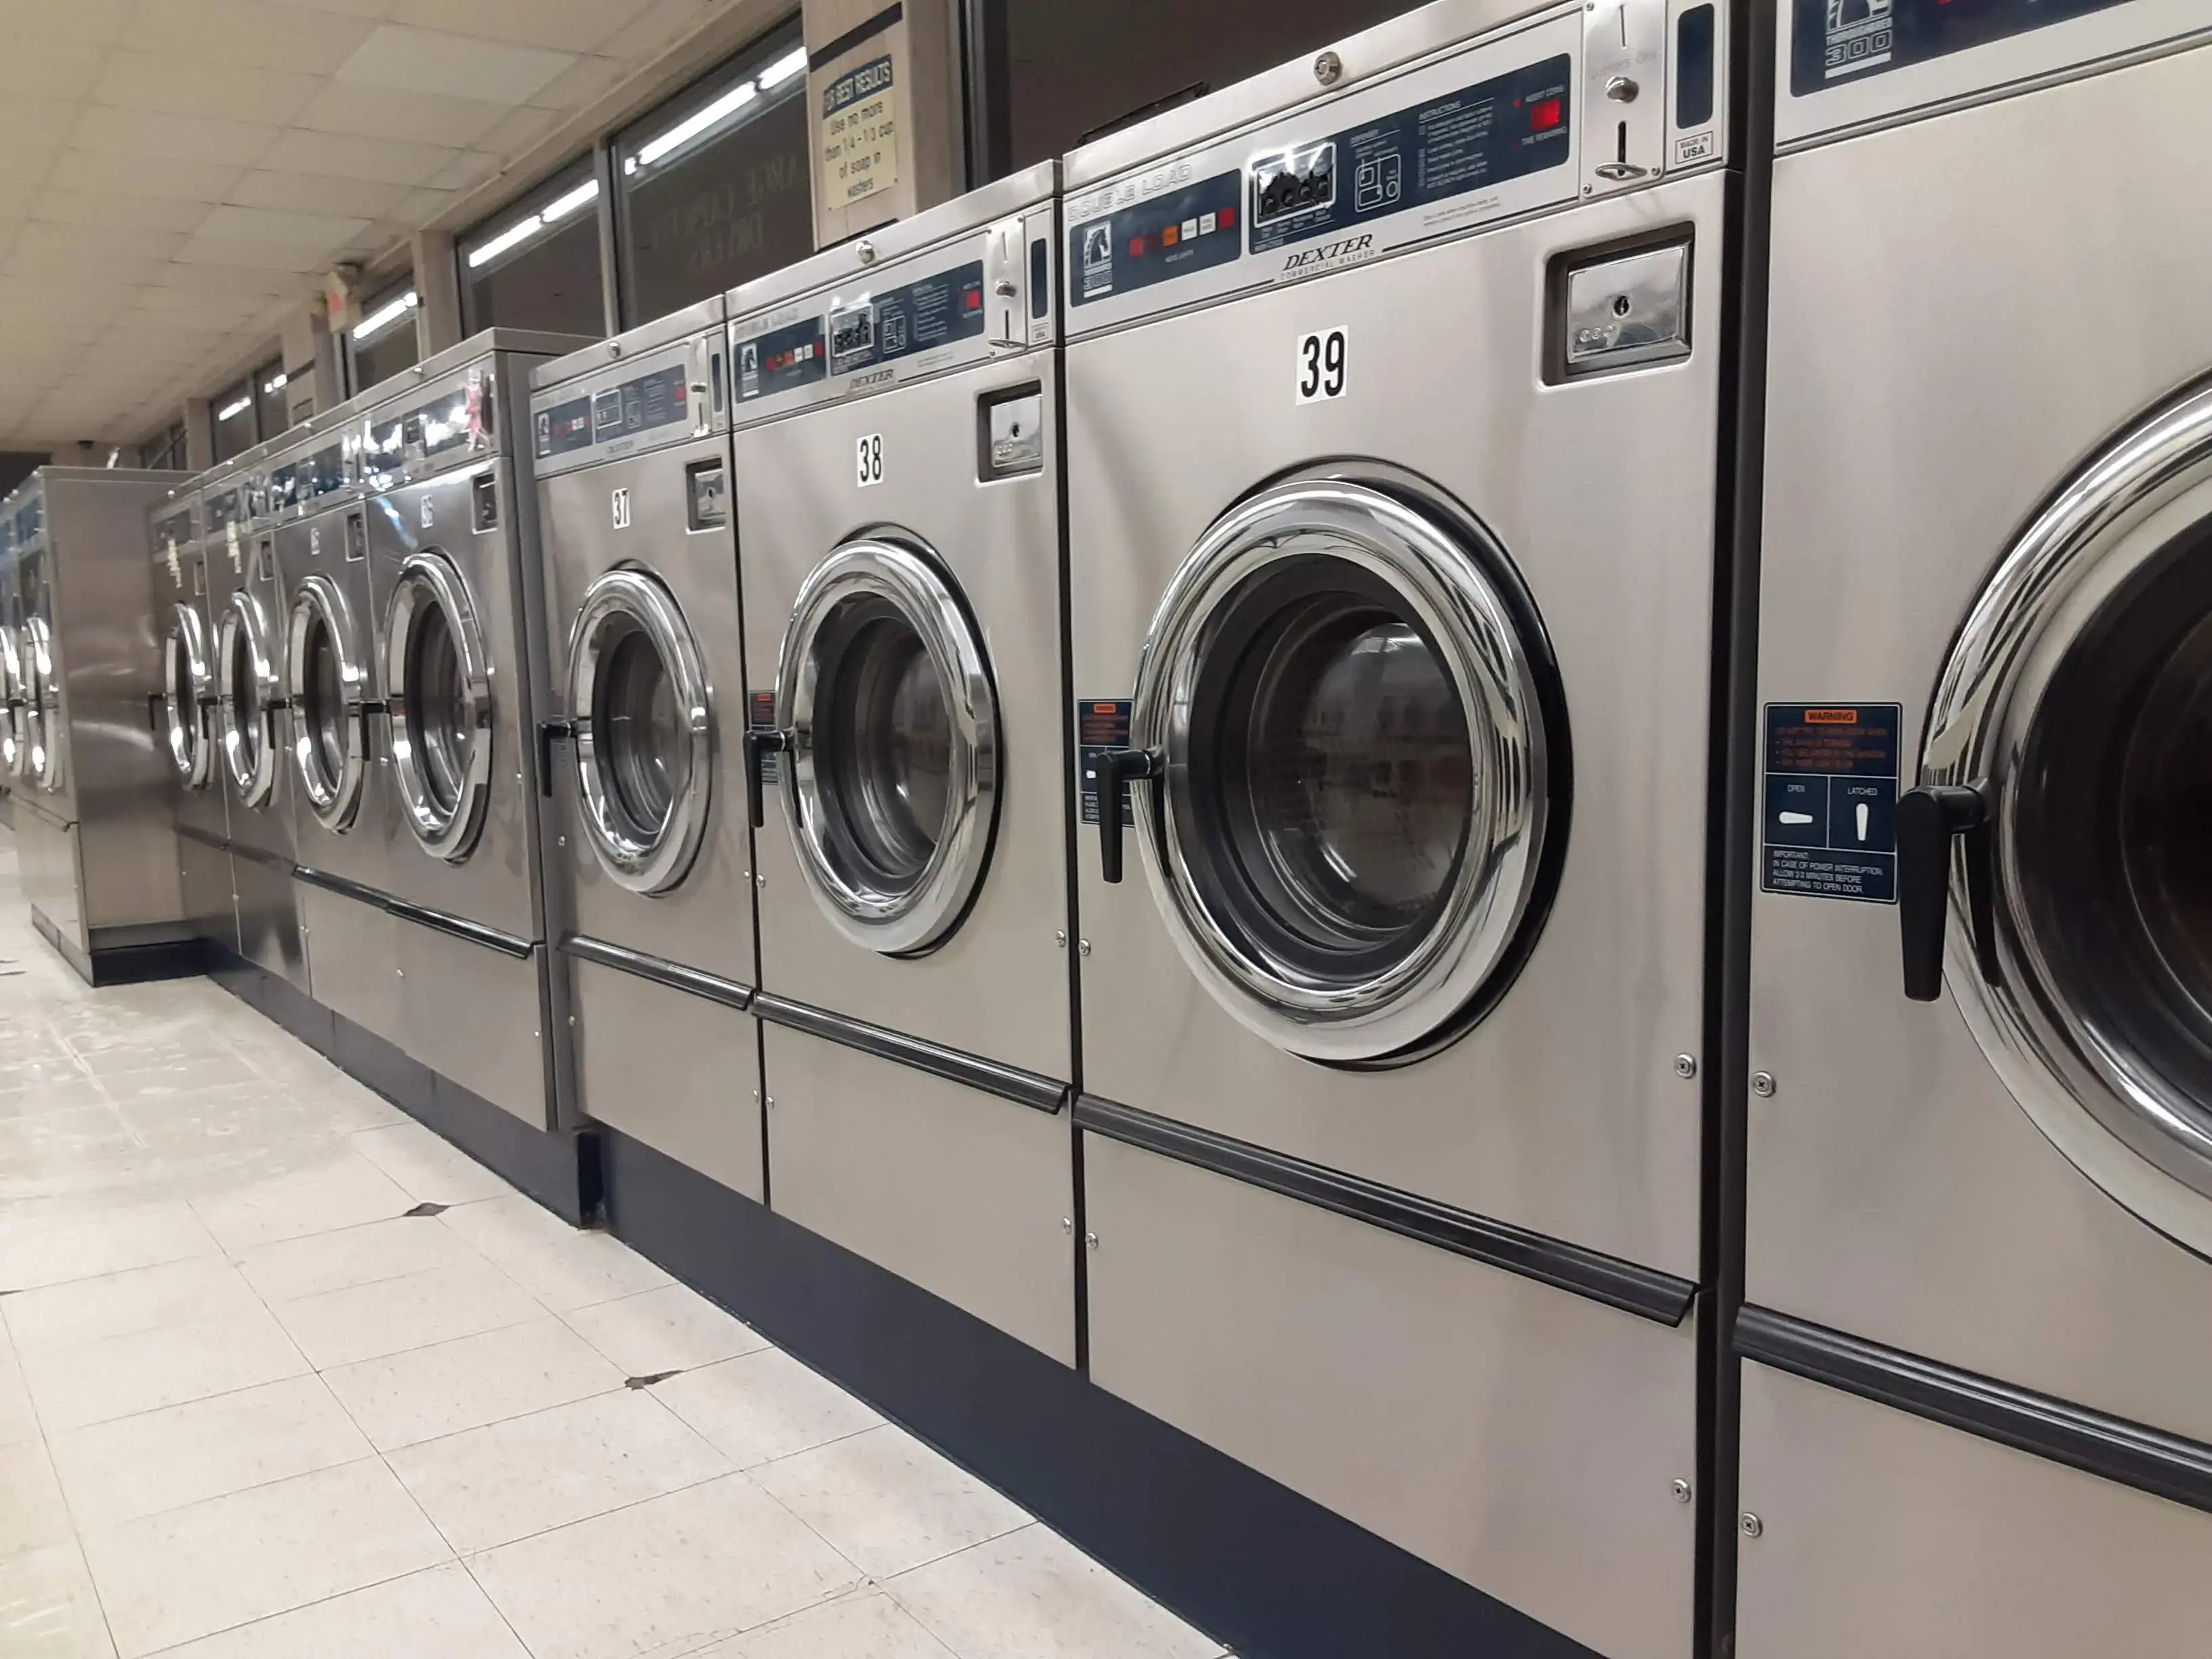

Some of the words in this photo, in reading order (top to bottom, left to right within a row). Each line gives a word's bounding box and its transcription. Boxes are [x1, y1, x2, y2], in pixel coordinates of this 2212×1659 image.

[1825, 28, 1892, 66] 300
[1683, 145, 1705, 159] USA
[1142, 164, 1192, 197] LOAD
[1282, 234, 1373, 271] DEXTER
[1280, 262, 1334, 280] COMMERCIAL
[1338, 249, 1375, 264] WASHER
[1300, 331, 1345, 398] 39
[859, 435, 882, 483] 38
[615, 489, 628, 526] 37
[1809, 712, 1854, 721] WARNING
[1787, 784, 1805, 792] OPEN
[1847, 787, 1878, 796] LATCHED
[1773, 869, 1794, 878] ALLOW
[1806, 872, 1833, 881] MINUTES
[1835, 874, 1862, 883] BEFORE
[1781, 860, 1797, 868] CASE
[1809, 862, 1833, 872] POWER
[1773, 878, 1811, 888] ATTEMPTING
[1813, 881, 1822, 890] TO
[1823, 882, 1841, 891] OPEN
